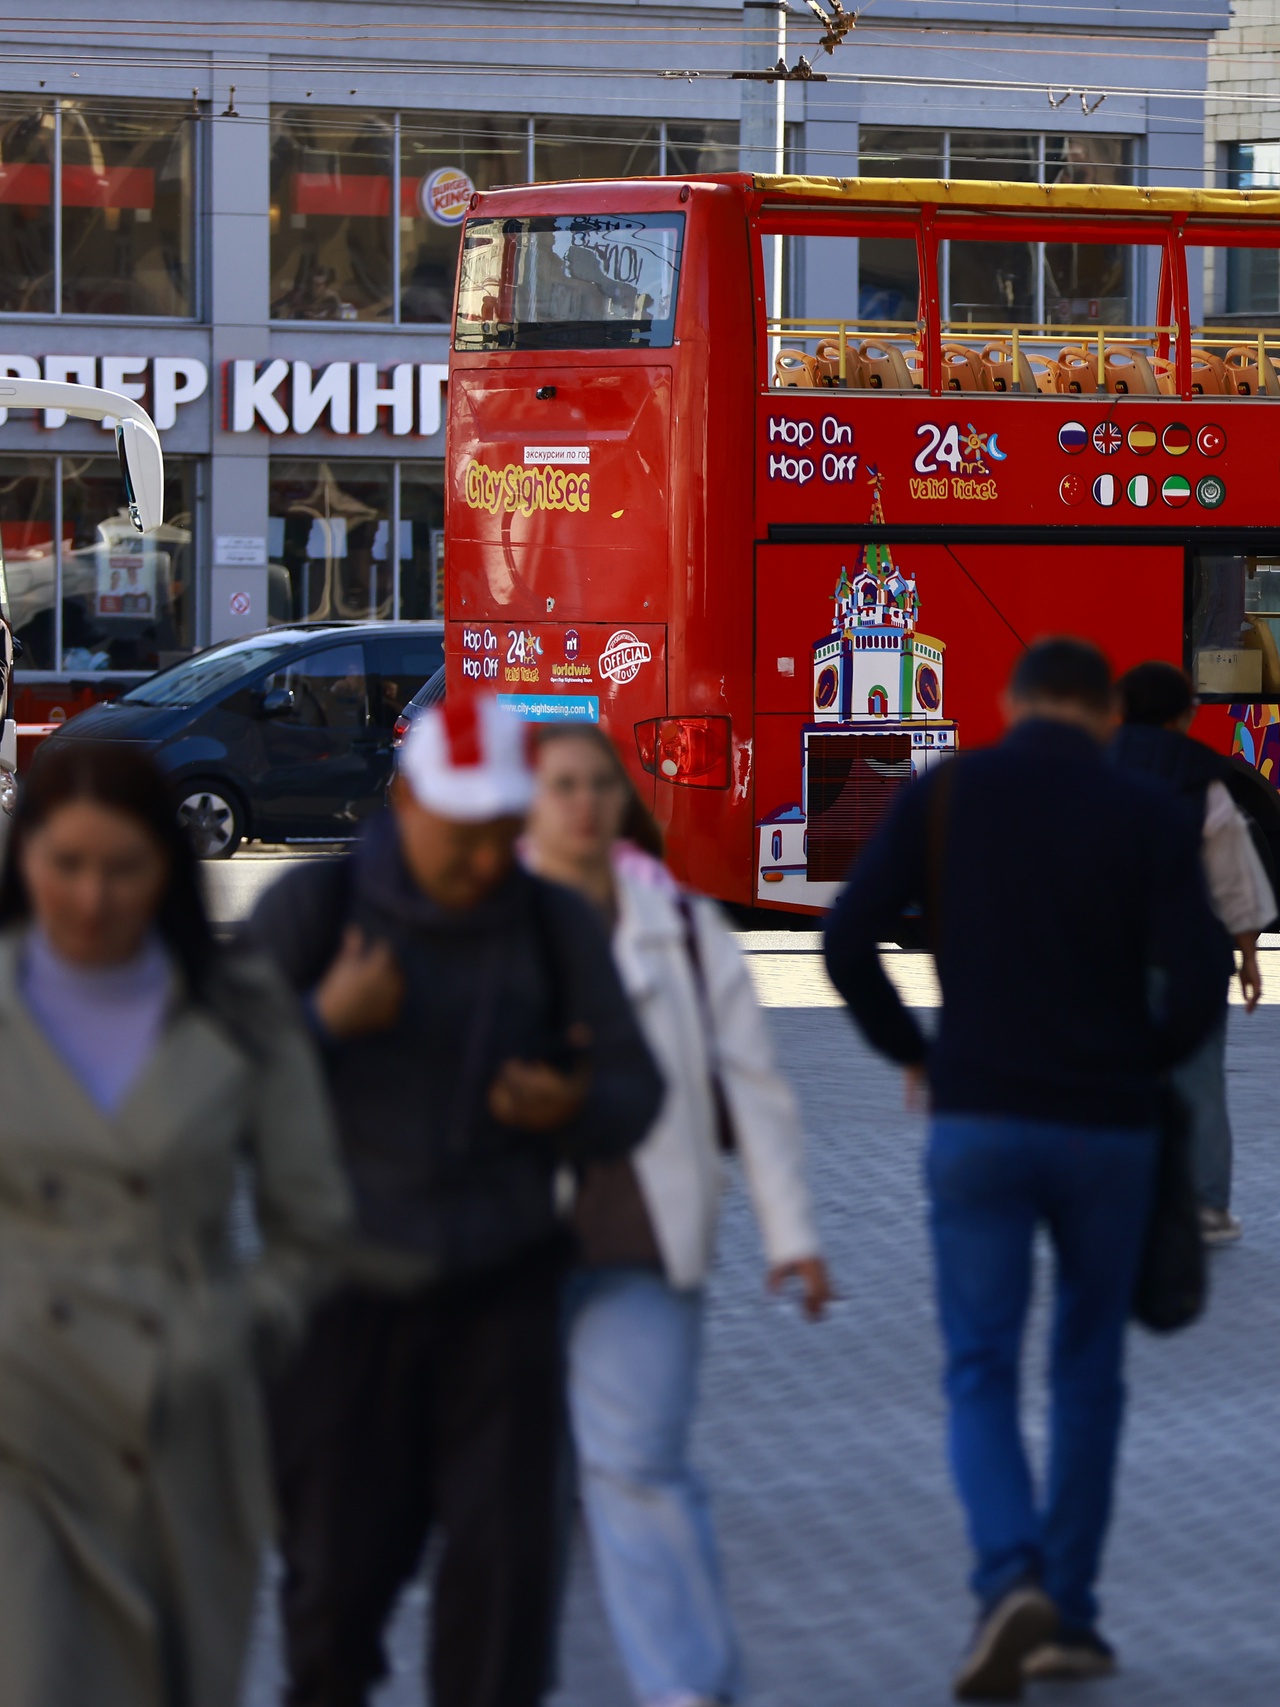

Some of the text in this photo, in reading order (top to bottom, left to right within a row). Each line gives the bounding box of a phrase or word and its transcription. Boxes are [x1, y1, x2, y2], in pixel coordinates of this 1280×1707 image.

[433, 188, 471, 211] KING
[770, 416, 852, 447] Hop On
[525, 451, 565, 461] экскурсии
[566, 451, 576, 459] по
[914, 424, 962, 473] 24
[770, 453, 858, 484] Hop Off
[909, 478, 998, 501] Valid Ticket
[463, 629, 498, 651] Hop On
[506, 630, 526, 664] 24
[463, 657, 499, 679] Hop Off
[551, 663, 592, 676] Worldwide
[604, 646, 648, 671] OFFICIAL
[617, 664, 637, 680] TOUR
[501, 703, 586, 716] www.city-sightseeing.com
